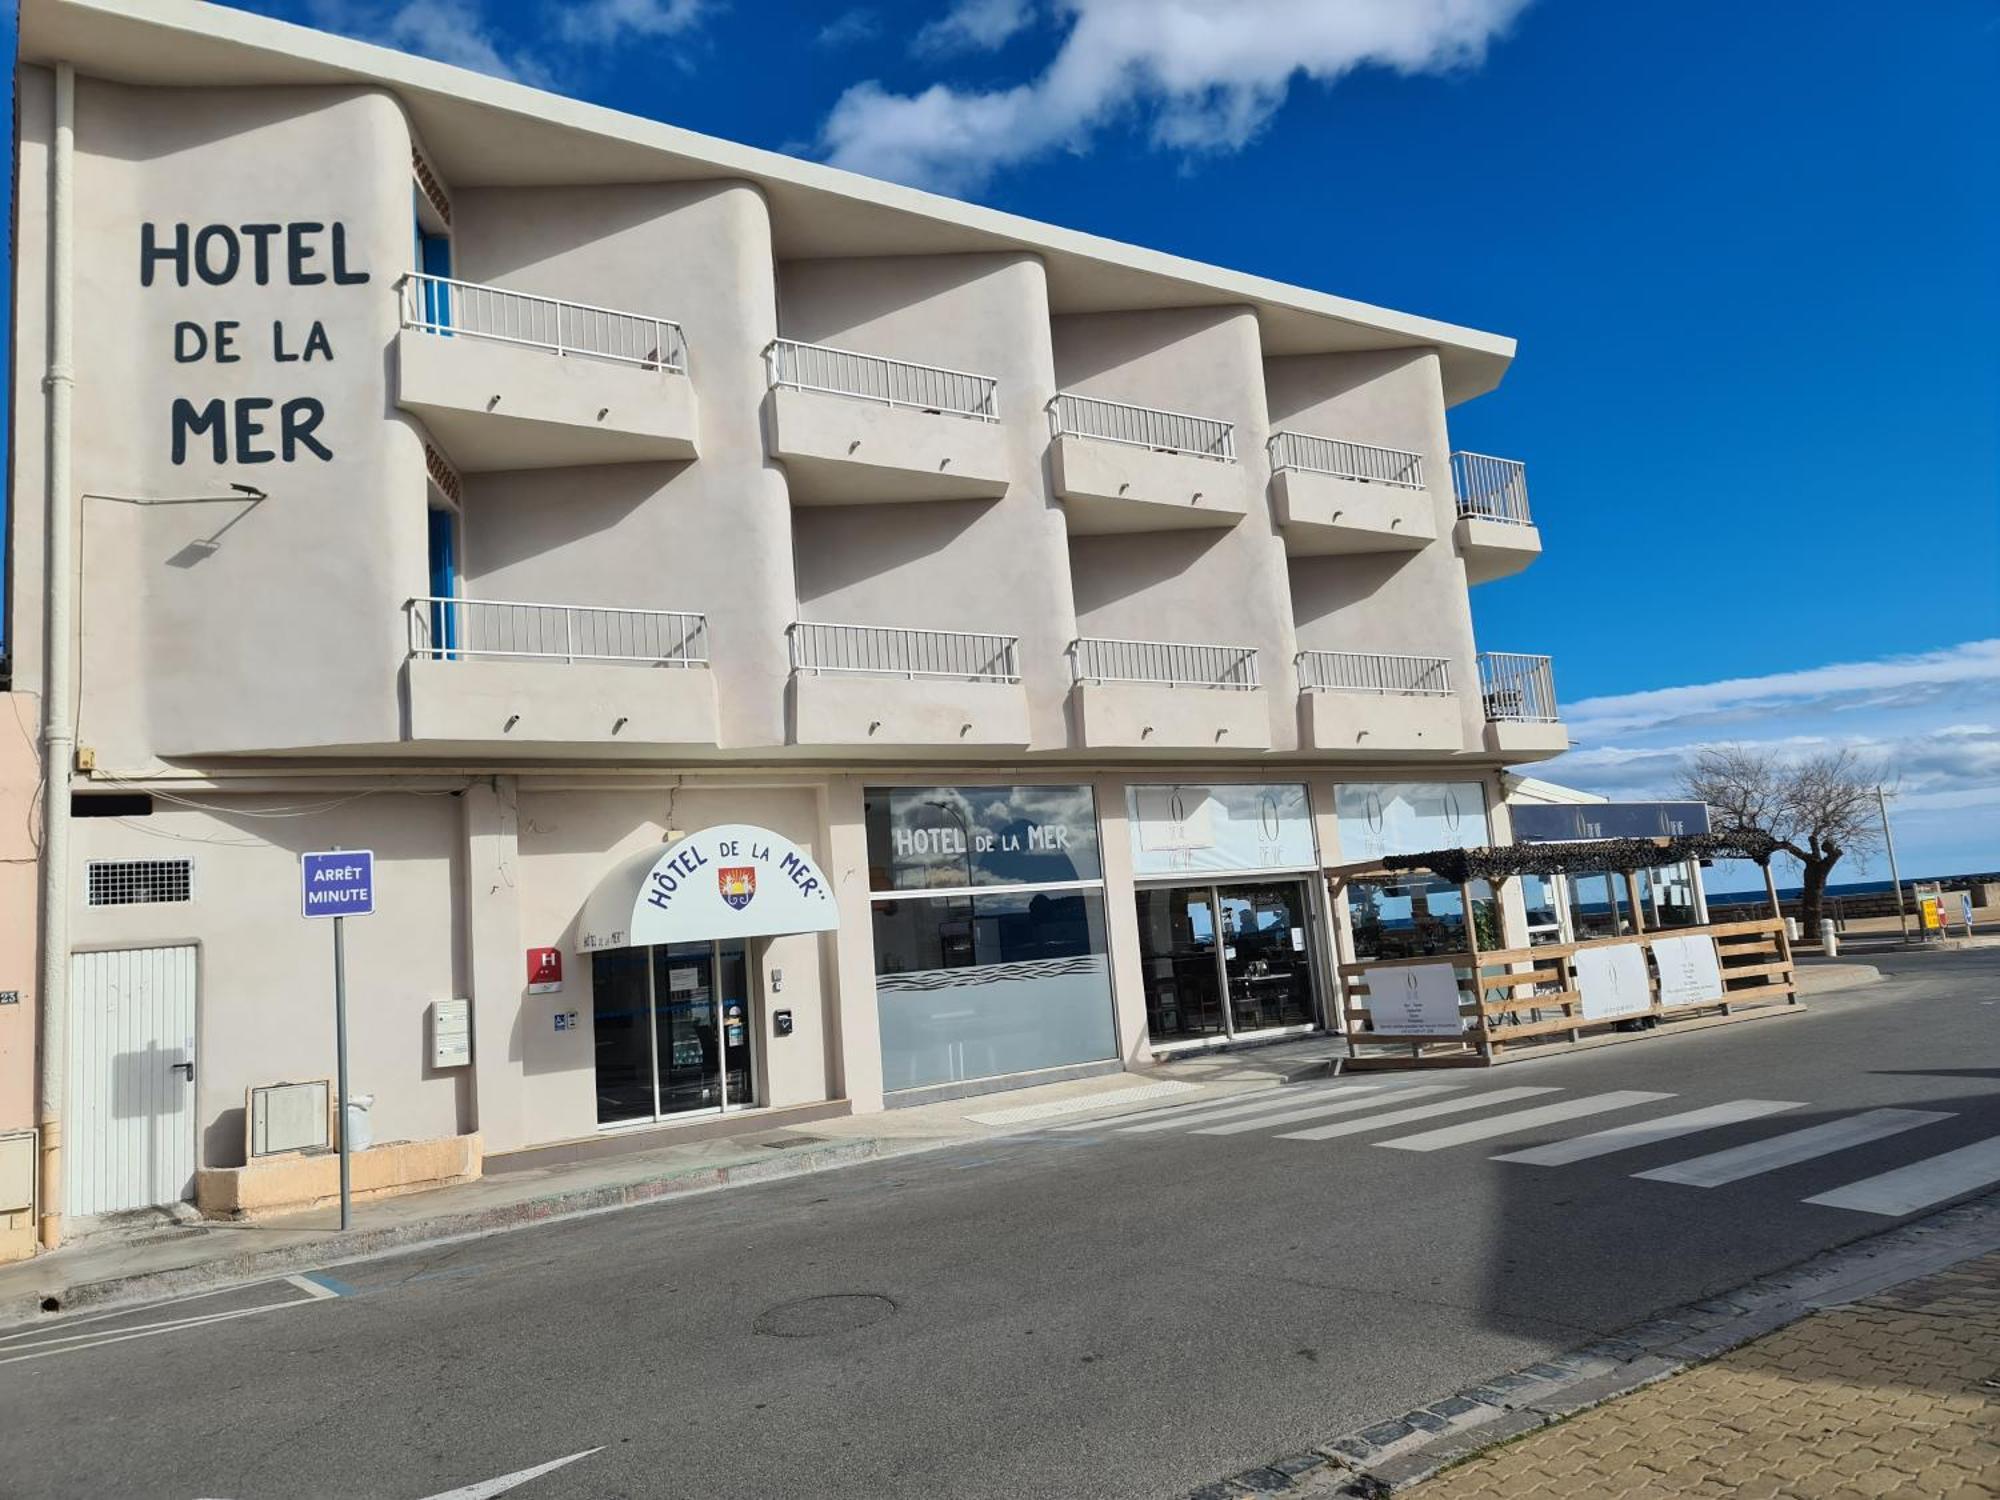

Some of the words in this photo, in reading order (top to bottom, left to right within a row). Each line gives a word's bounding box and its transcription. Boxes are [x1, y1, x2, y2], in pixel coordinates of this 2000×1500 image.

[141, 222, 370, 287] HOTEL
[174, 321, 241, 363] DE
[273, 320, 334, 362] LA
[171, 397, 333, 465] MER
[896, 828, 967, 856] HOTEL
[975, 836, 995, 853] DE
[1002, 834, 1020, 851] LA
[1027, 825, 1072, 850] MER
[313, 865, 363, 882] ARRÊT
[647, 845, 708, 910] HÔTEL
[719, 841, 739, 857] DE
[752, 843, 769, 862] LA
[308, 888, 369, 904] MINUTE
[541, 953, 556, 966] H
